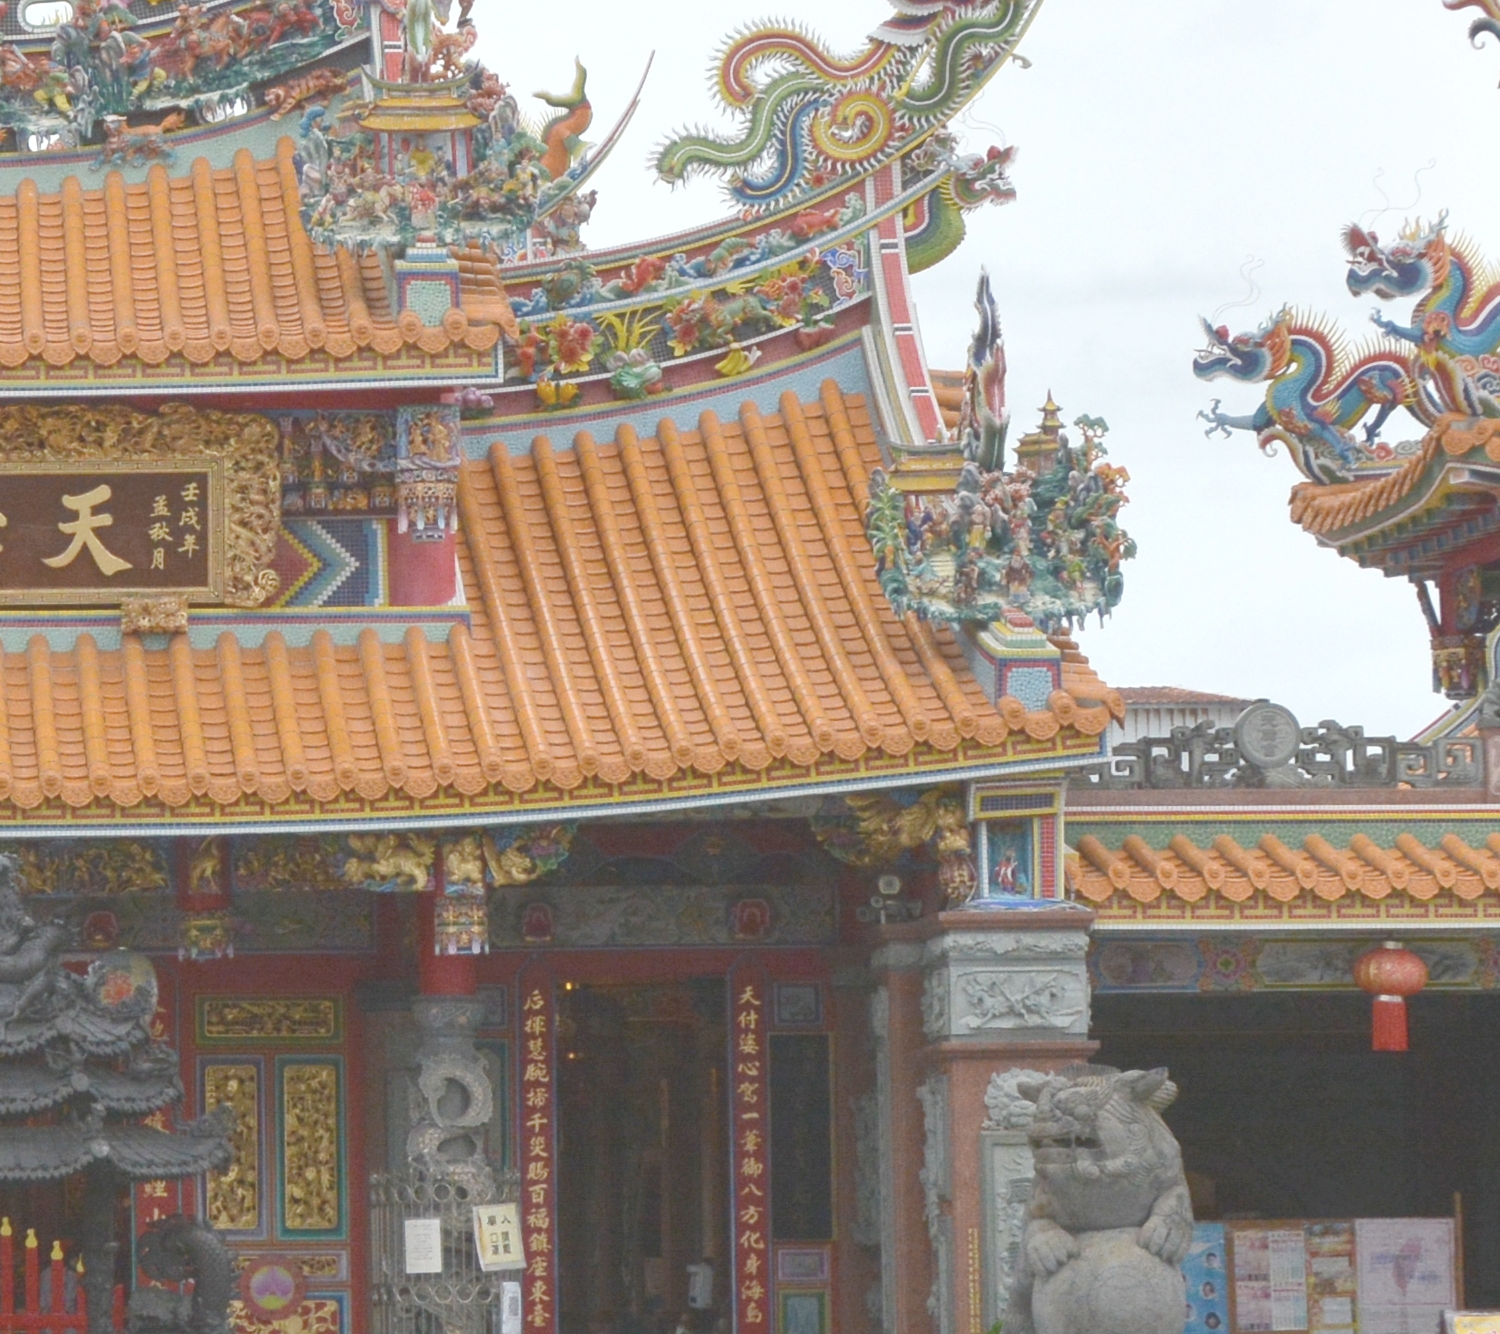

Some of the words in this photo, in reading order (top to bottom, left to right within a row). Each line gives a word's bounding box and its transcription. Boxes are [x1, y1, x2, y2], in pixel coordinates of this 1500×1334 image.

[149, 495, 174, 571] 孟秋月
[178, 482, 201, 559] 壬戌年
